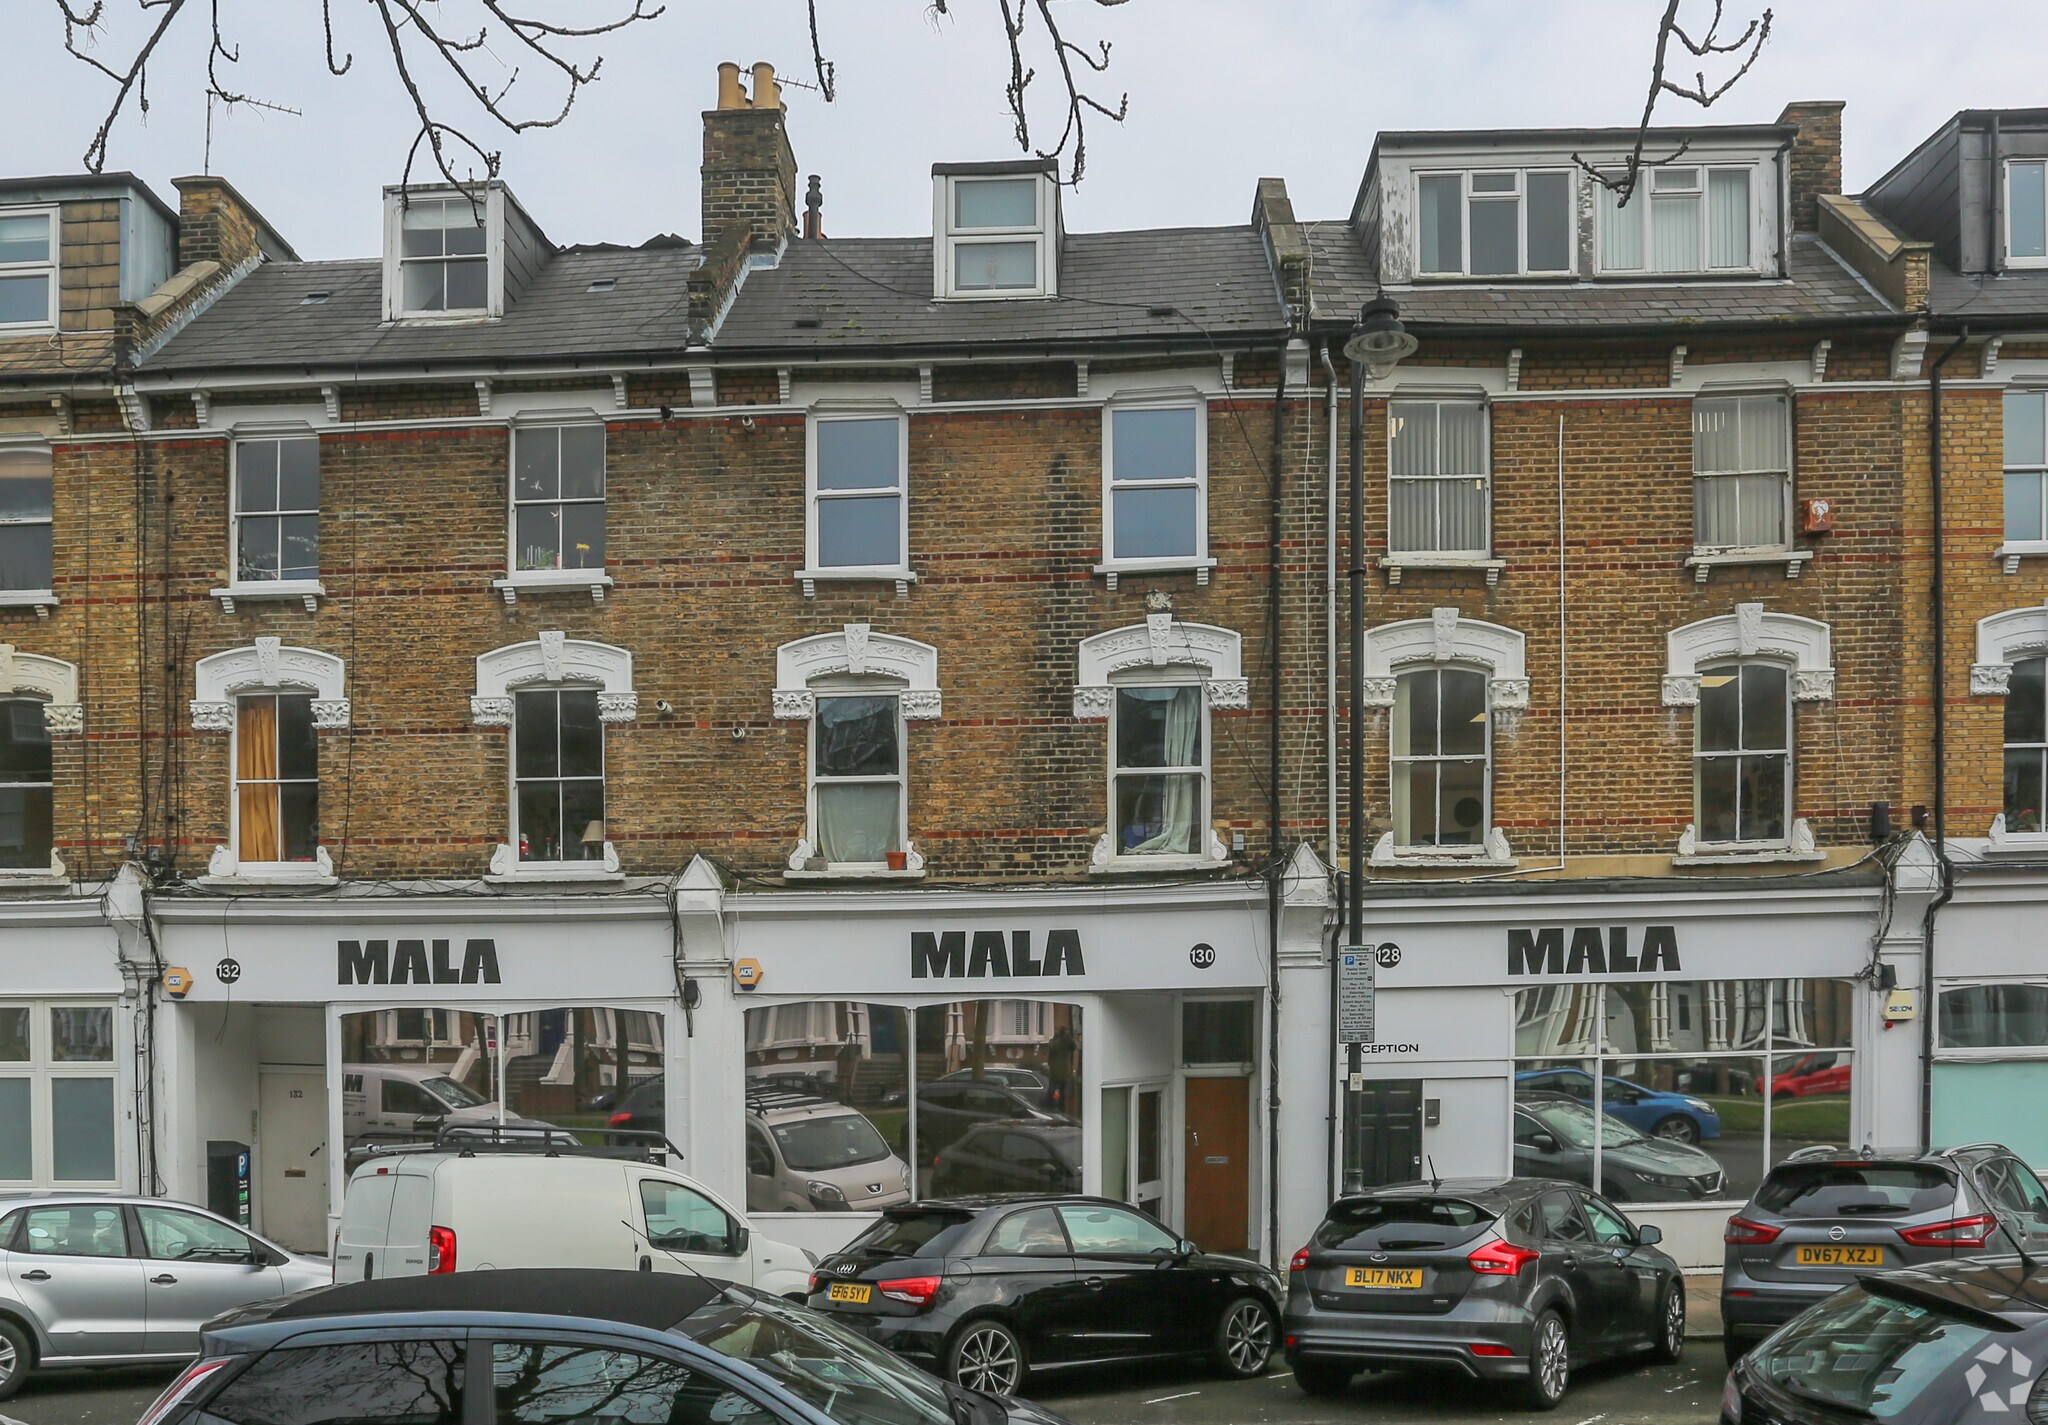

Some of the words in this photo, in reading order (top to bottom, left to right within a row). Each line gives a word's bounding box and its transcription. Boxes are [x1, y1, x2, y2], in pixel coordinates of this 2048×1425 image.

[911, 929, 1086, 978] MALA
[1190, 949, 1215, 963] 130
[1377, 948, 1401, 963] 128
[1508, 926, 1682, 975] MALA
[338, 939, 502, 984] MALA
[216, 964, 239, 978] 132
[1344, 1044, 1419, 1054] CEPTION
[289, 1090, 303, 1099] 132
[1803, 1248, 1841, 1262] DV67
[1846, 1249, 1877, 1263] XZJ
[1354, 1269, 1384, 1284] BL17
[1387, 1270, 1414, 1284] NKX
[831, 1285, 849, 1299] EF16
[850, 1286, 868, 1300] SYY
